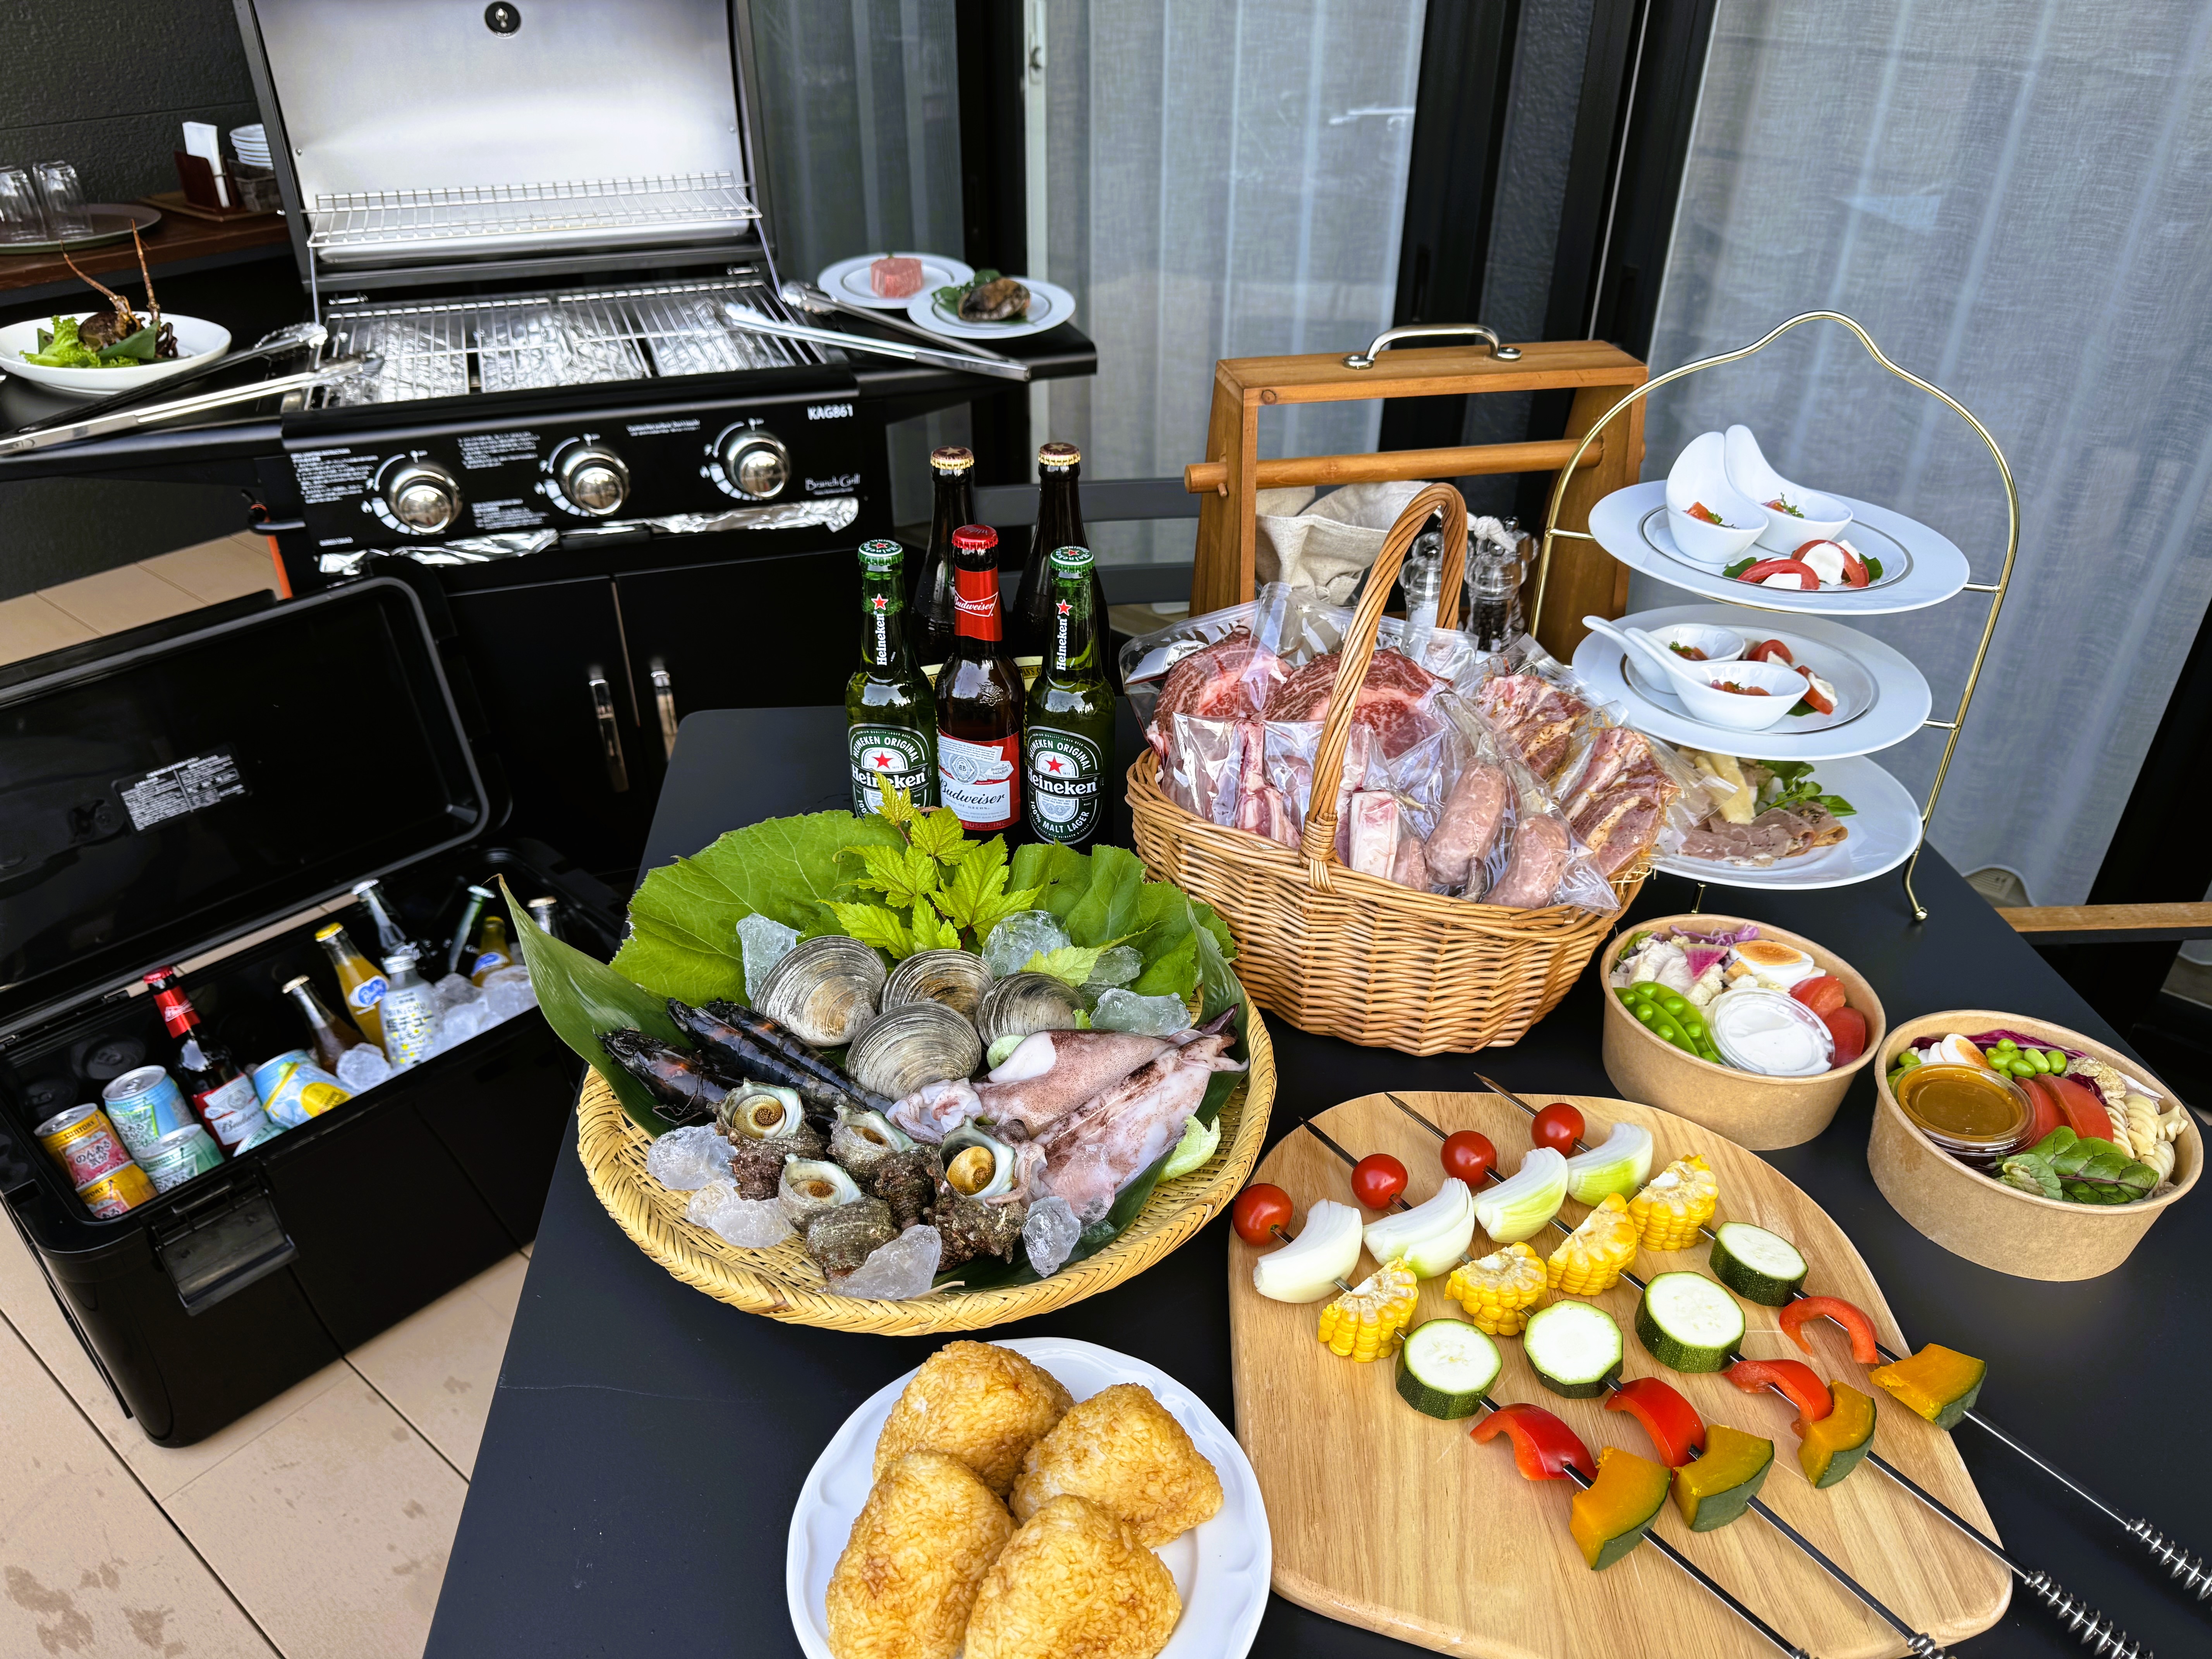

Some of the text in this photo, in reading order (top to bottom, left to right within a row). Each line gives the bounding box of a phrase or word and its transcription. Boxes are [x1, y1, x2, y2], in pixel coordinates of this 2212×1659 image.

[955, 596, 994, 611] Budweiser
[876, 613, 887, 665] Heineken
[1056, 618, 1067, 671] Heineken
[853, 736, 881, 758] HEINEKEN
[884, 737, 919, 762] ORIGINAL
[1029, 739, 1053, 760] HEINEKEN
[1057, 742, 1091, 771] ORIGINAL
[940, 779, 1005, 804] Budweiser
[1028, 766, 1097, 795] Heineken
[857, 800, 869, 813] 100
[1030, 801, 1041, 823] 100%
[1042, 821, 1063, 833] MALT
[1067, 811, 1090, 832] LAGER
[76, 1140, 111, 1163] のんある
[89, 1152, 109, 1168] 気分
